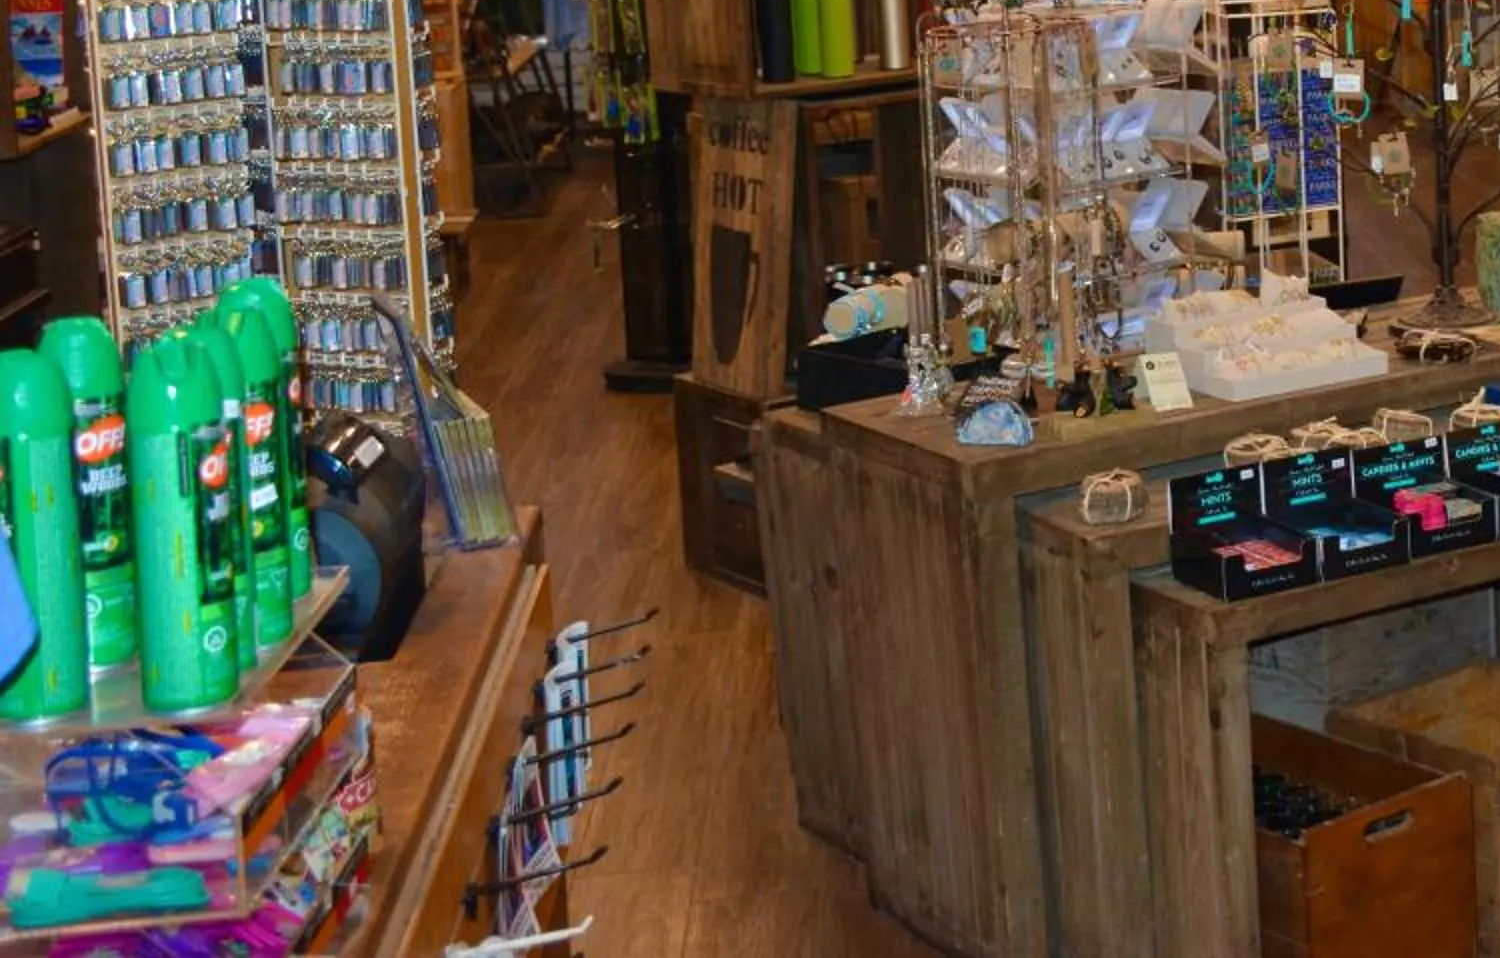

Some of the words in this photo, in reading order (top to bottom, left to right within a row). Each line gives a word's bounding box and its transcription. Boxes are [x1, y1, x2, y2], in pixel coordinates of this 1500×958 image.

[707, 116, 770, 156] coffee
[709, 170, 767, 215] HOT
[1291, 473, 1322, 488] MINTS
[1201, 491, 1232, 506] MINTS
